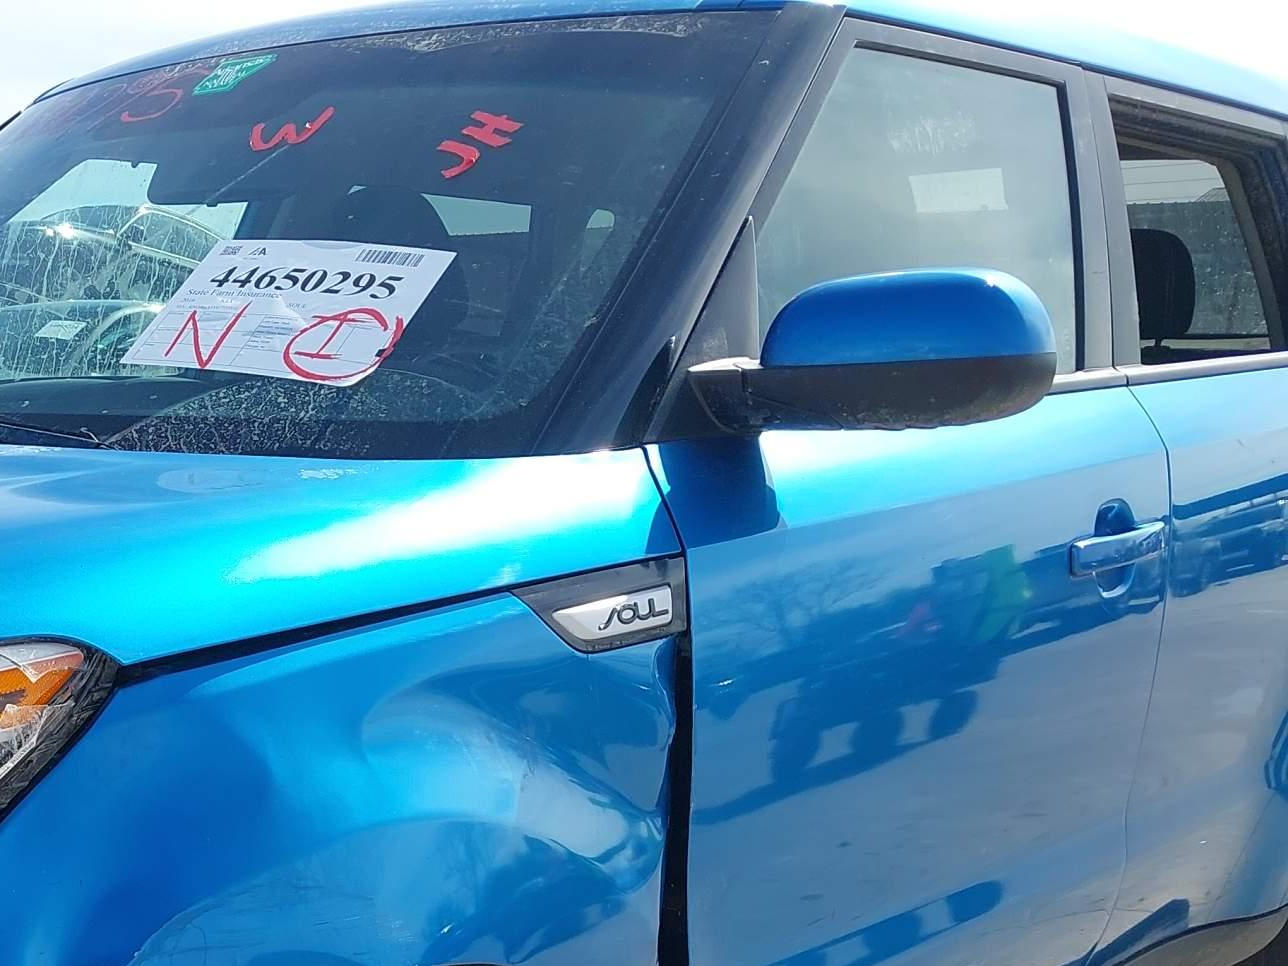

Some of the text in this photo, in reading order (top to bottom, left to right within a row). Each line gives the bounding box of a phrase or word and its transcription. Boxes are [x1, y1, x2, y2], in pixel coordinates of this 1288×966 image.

[187, 288, 282, 299] State Farm Insurance
[210, 266, 405, 300] 44650295
[163, 300, 252, 369] N
[598, 598, 669, 631] SOUL
